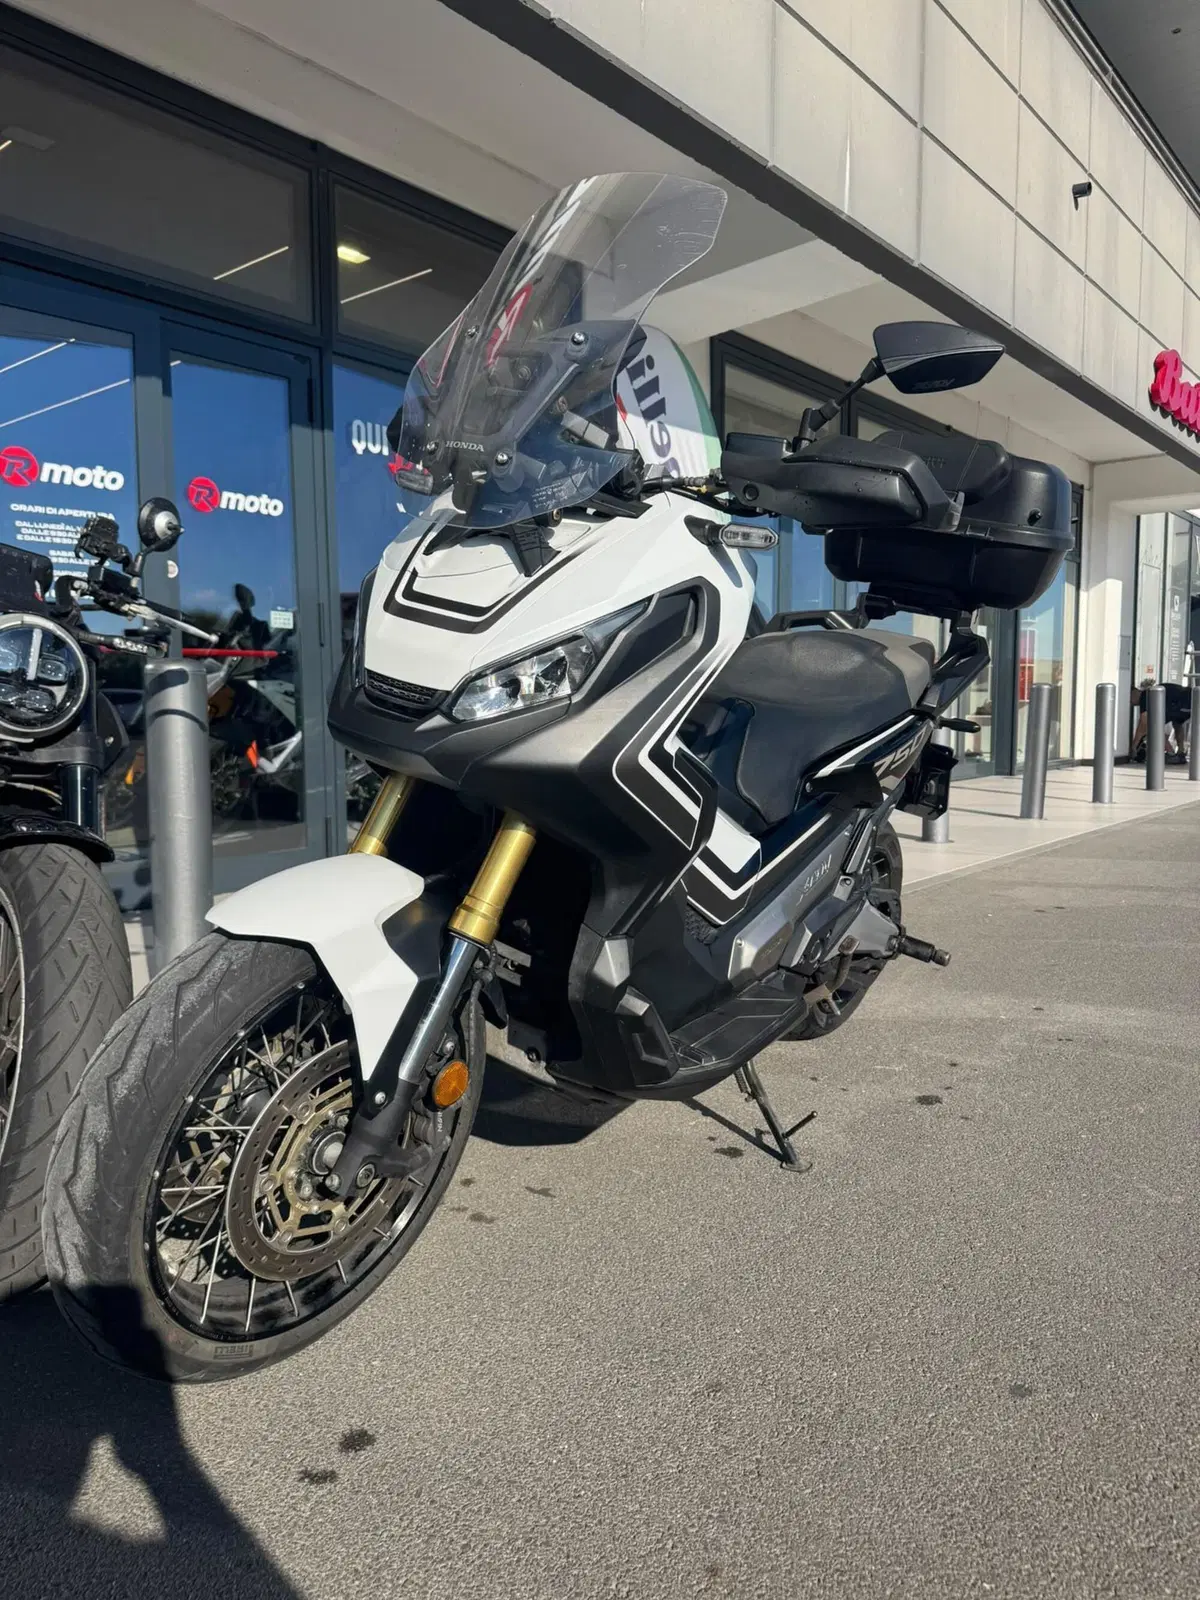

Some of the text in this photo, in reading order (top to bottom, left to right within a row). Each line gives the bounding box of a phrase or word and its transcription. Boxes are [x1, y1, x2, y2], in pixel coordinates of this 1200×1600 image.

[445, 440, 485, 452] HONDA
[40, 462, 124, 491] moto
[10, 503, 45, 514] ORARI
[46, 506, 57, 515] DI
[219, 490, 284, 517] moto
